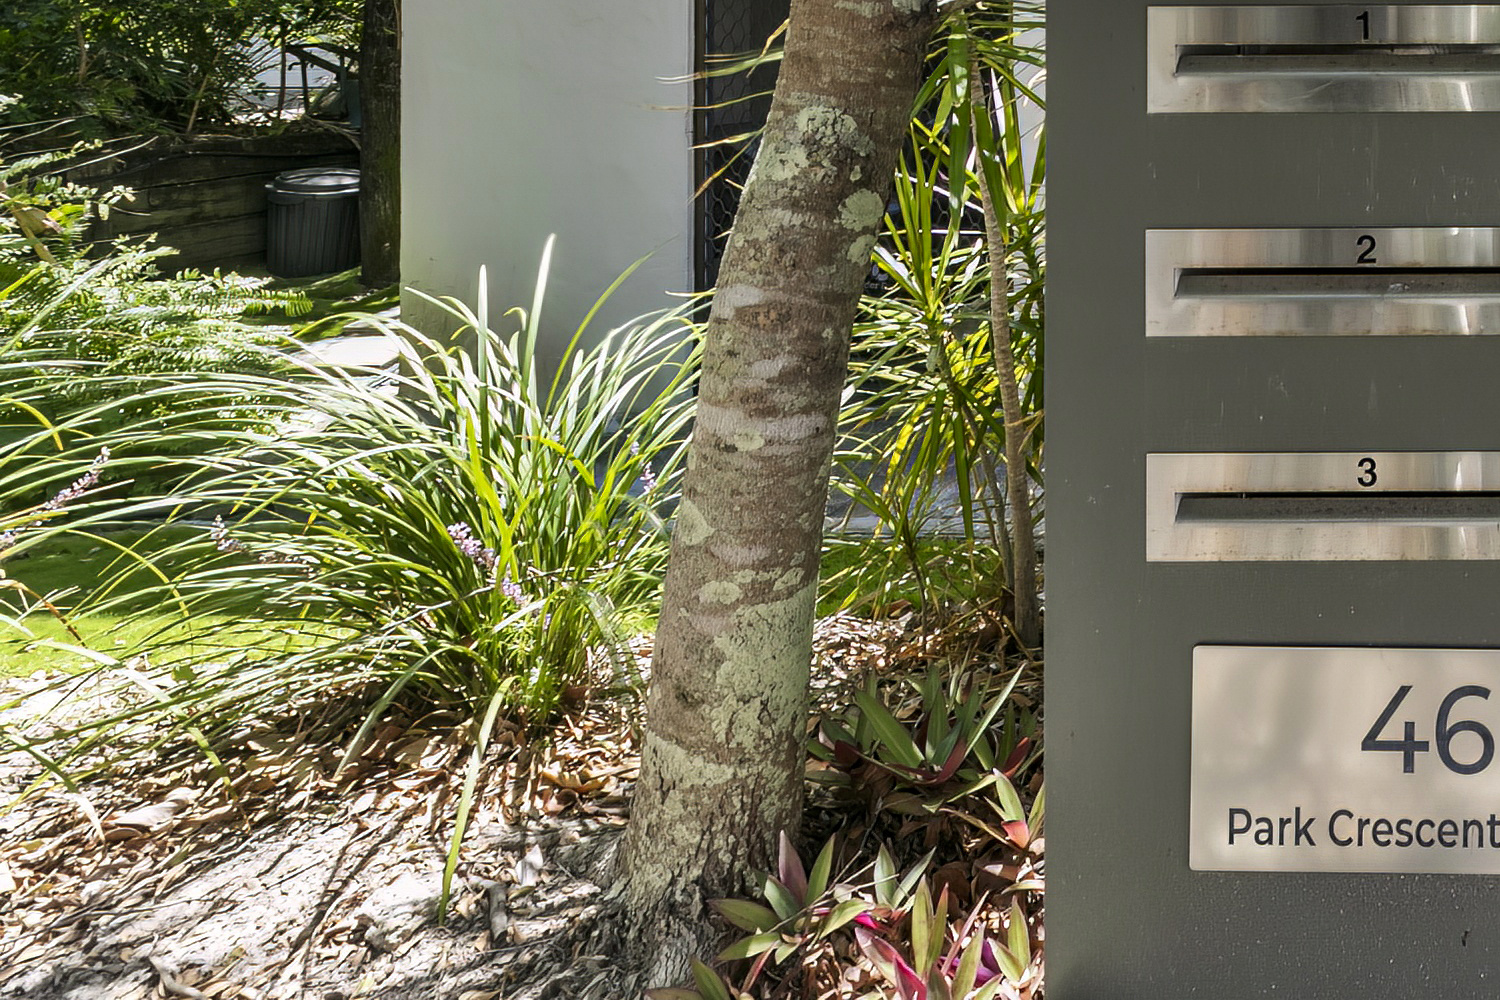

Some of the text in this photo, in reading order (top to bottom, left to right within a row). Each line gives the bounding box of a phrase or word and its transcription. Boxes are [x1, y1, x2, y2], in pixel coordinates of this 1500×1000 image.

[1355, 10, 1369, 40] 1
[1355, 235, 1377, 265] 2
[1356, 457, 1378, 488] 3
[1361, 684, 1496, 775] 46
[1228, 806, 1317, 848] Park
